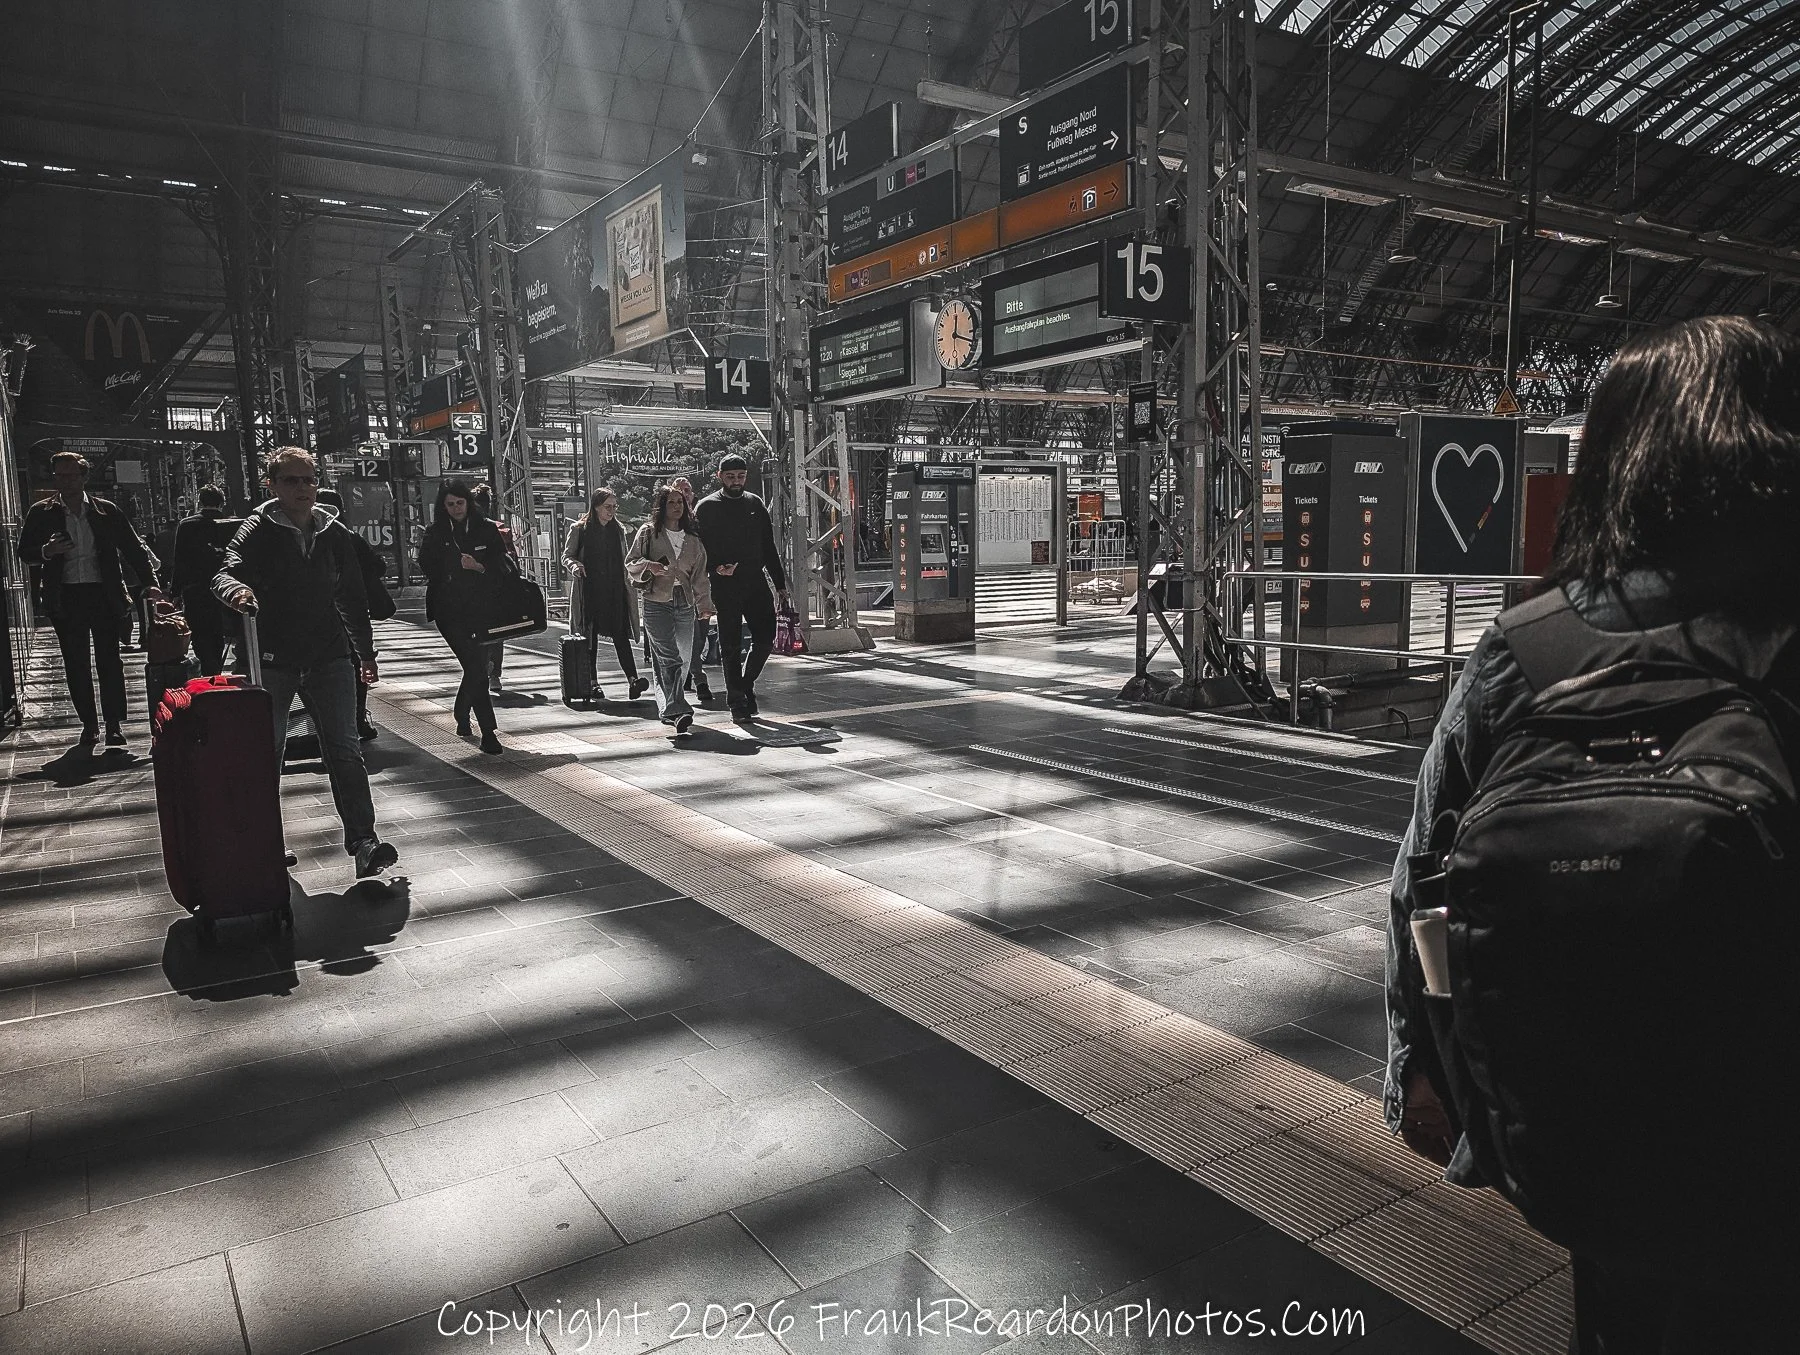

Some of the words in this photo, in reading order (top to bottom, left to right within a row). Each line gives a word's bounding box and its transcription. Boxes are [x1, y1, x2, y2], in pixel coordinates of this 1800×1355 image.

[1084, 0, 1118, 41] 15
[1018, 116, 1028, 134] S
[1050, 116, 1078, 136] Ausgang
[1080, 106, 1097, 122] Nord
[1047, 134, 1072, 151] Fußweg
[1074, 124, 1097, 140] Messe
[828, 131, 848, 170] 14
[887, 175, 895, 192] U
[1086, 194, 1093, 208] P
[861, 205, 870, 215] City
[929, 247, 935, 262] P
[1118, 243, 1164, 302] 15
[526, 280, 540, 302] Weiß
[541, 282, 548, 296] zu
[1006, 300, 1024, 313] Bitte
[1004, 318, 1045, 334] Aushangfahrplan
[1046, 313, 1071, 325] beachten.
[1106, 334, 1118, 342] Gleis
[842, 344, 858, 356] Kassel
[715, 359, 750, 394] 14
[841, 368, 857, 379] Siegen
[454, 434, 478, 456] 13
[605, 438, 673, 476] Highwalk
[358, 461, 378, 477] 12
[900, 539, 905, 548] S
[1300, 534, 1310, 547] S
[1363, 533, 1371, 545] S
[1300, 556, 1309, 567] U
[1363, 556, 1370, 566] U
